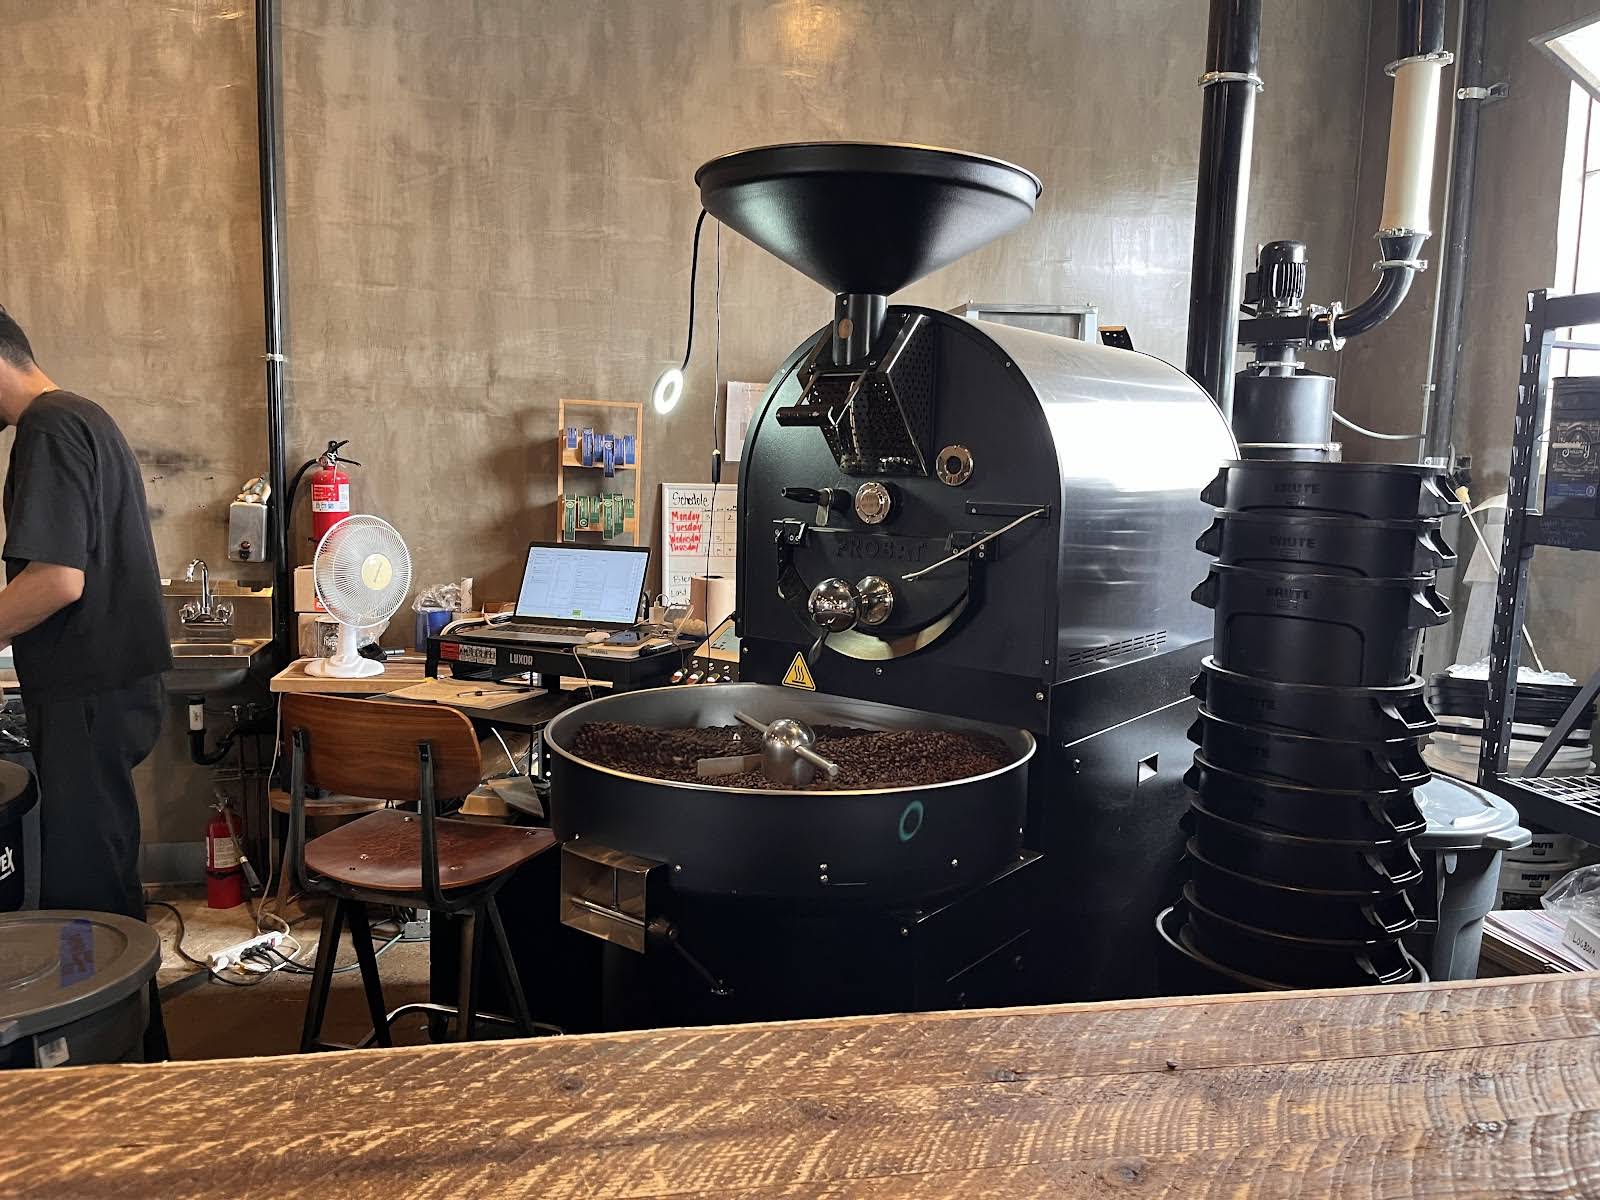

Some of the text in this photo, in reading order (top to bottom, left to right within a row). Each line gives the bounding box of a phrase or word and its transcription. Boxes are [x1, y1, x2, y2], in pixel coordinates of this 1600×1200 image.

[671, 510, 701, 523] Monday
[671, 522, 703, 533] Tuesday
[509, 652, 533, 666] LUXOR
